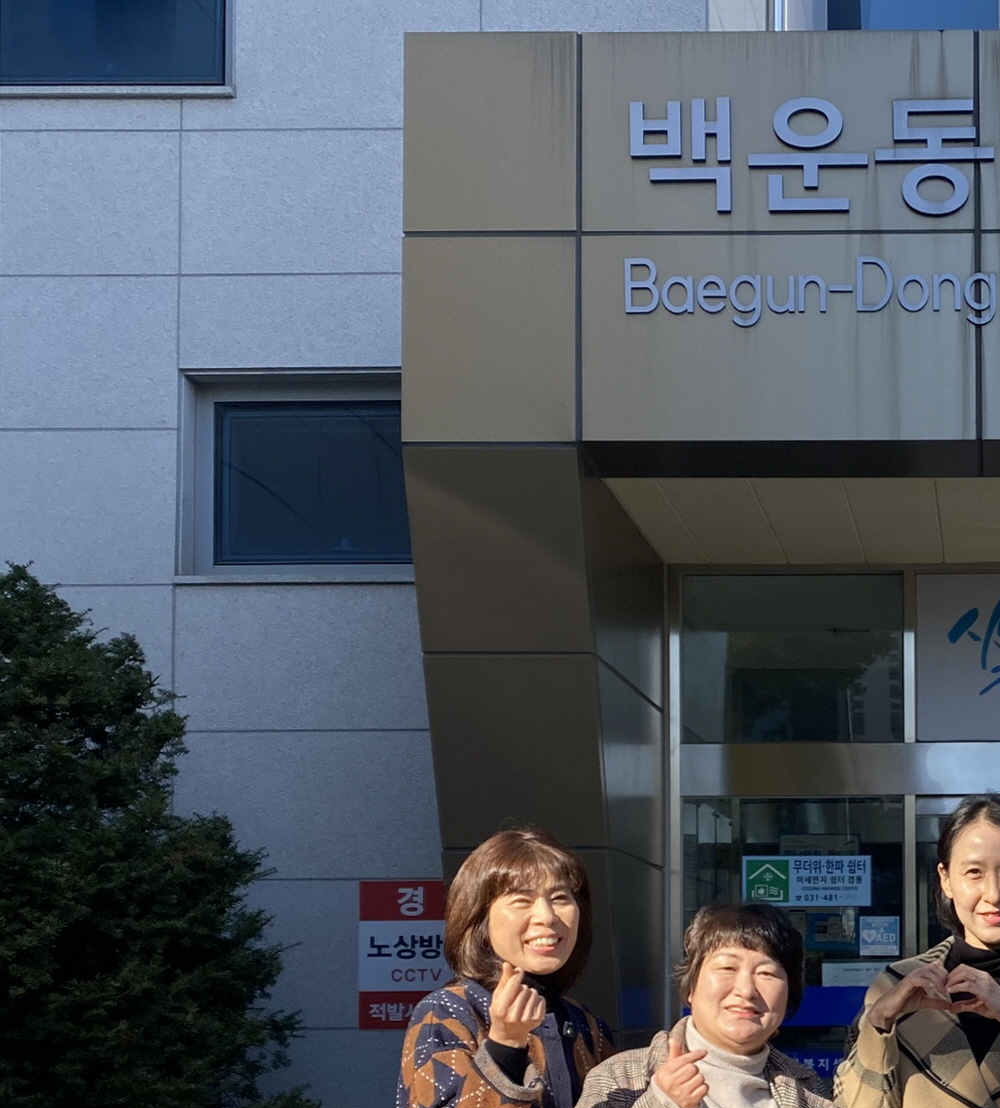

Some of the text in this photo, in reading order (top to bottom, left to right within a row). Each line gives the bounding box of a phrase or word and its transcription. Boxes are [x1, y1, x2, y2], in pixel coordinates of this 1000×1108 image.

[624, 255, 997, 327] Baegun-Dong
[847, 860, 866, 874] 쉼터
[796, 875, 827, 885] 미세먼지
[830, 876, 844, 885] 쉼터
[397, 886, 424, 917] 경
[876, 932, 896, 943] AED
[391, 968, 442, 982] CCTV
